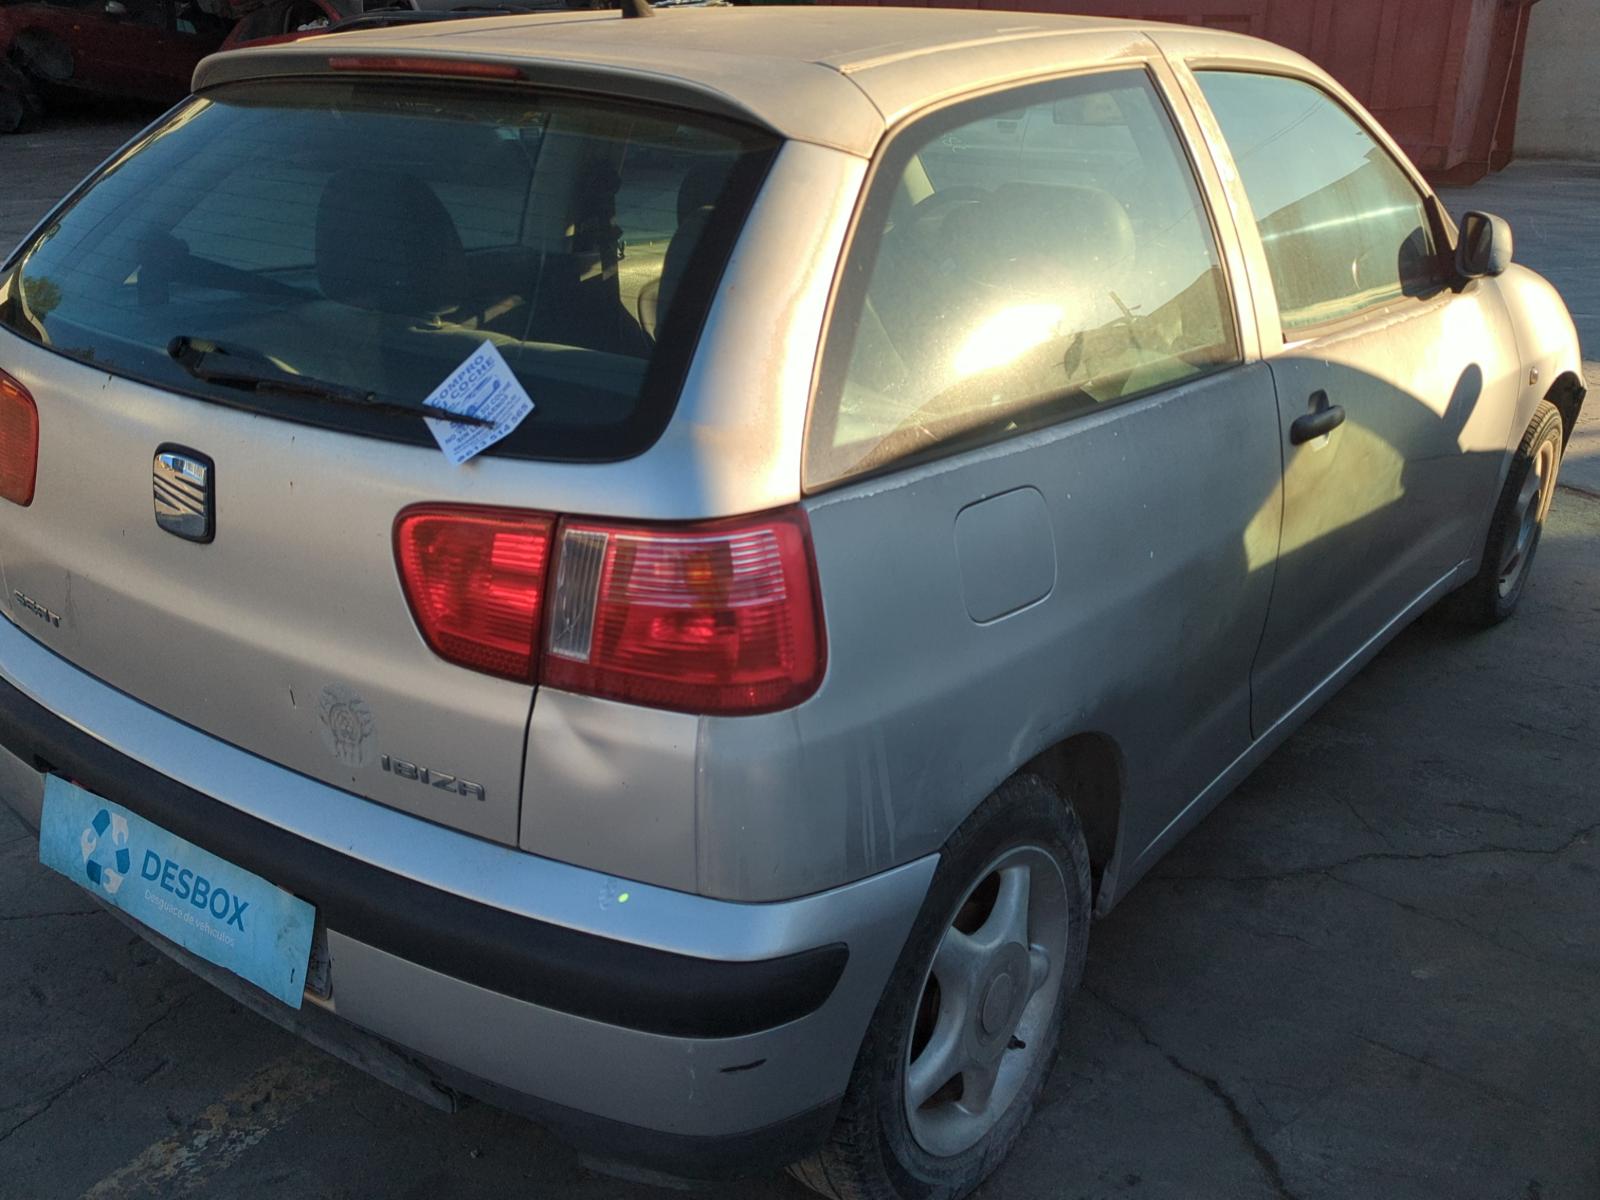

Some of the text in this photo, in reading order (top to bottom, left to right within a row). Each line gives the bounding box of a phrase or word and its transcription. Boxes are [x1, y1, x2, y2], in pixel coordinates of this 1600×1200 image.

[431, 355, 485, 407] COMPRO
[450, 356, 495, 400] COCHE
[381, 753, 486, 802] IBIZA
[141, 849, 250, 932] DESBOX
[144, 889, 183, 919] Desguace
[183, 911, 195, 926] de
